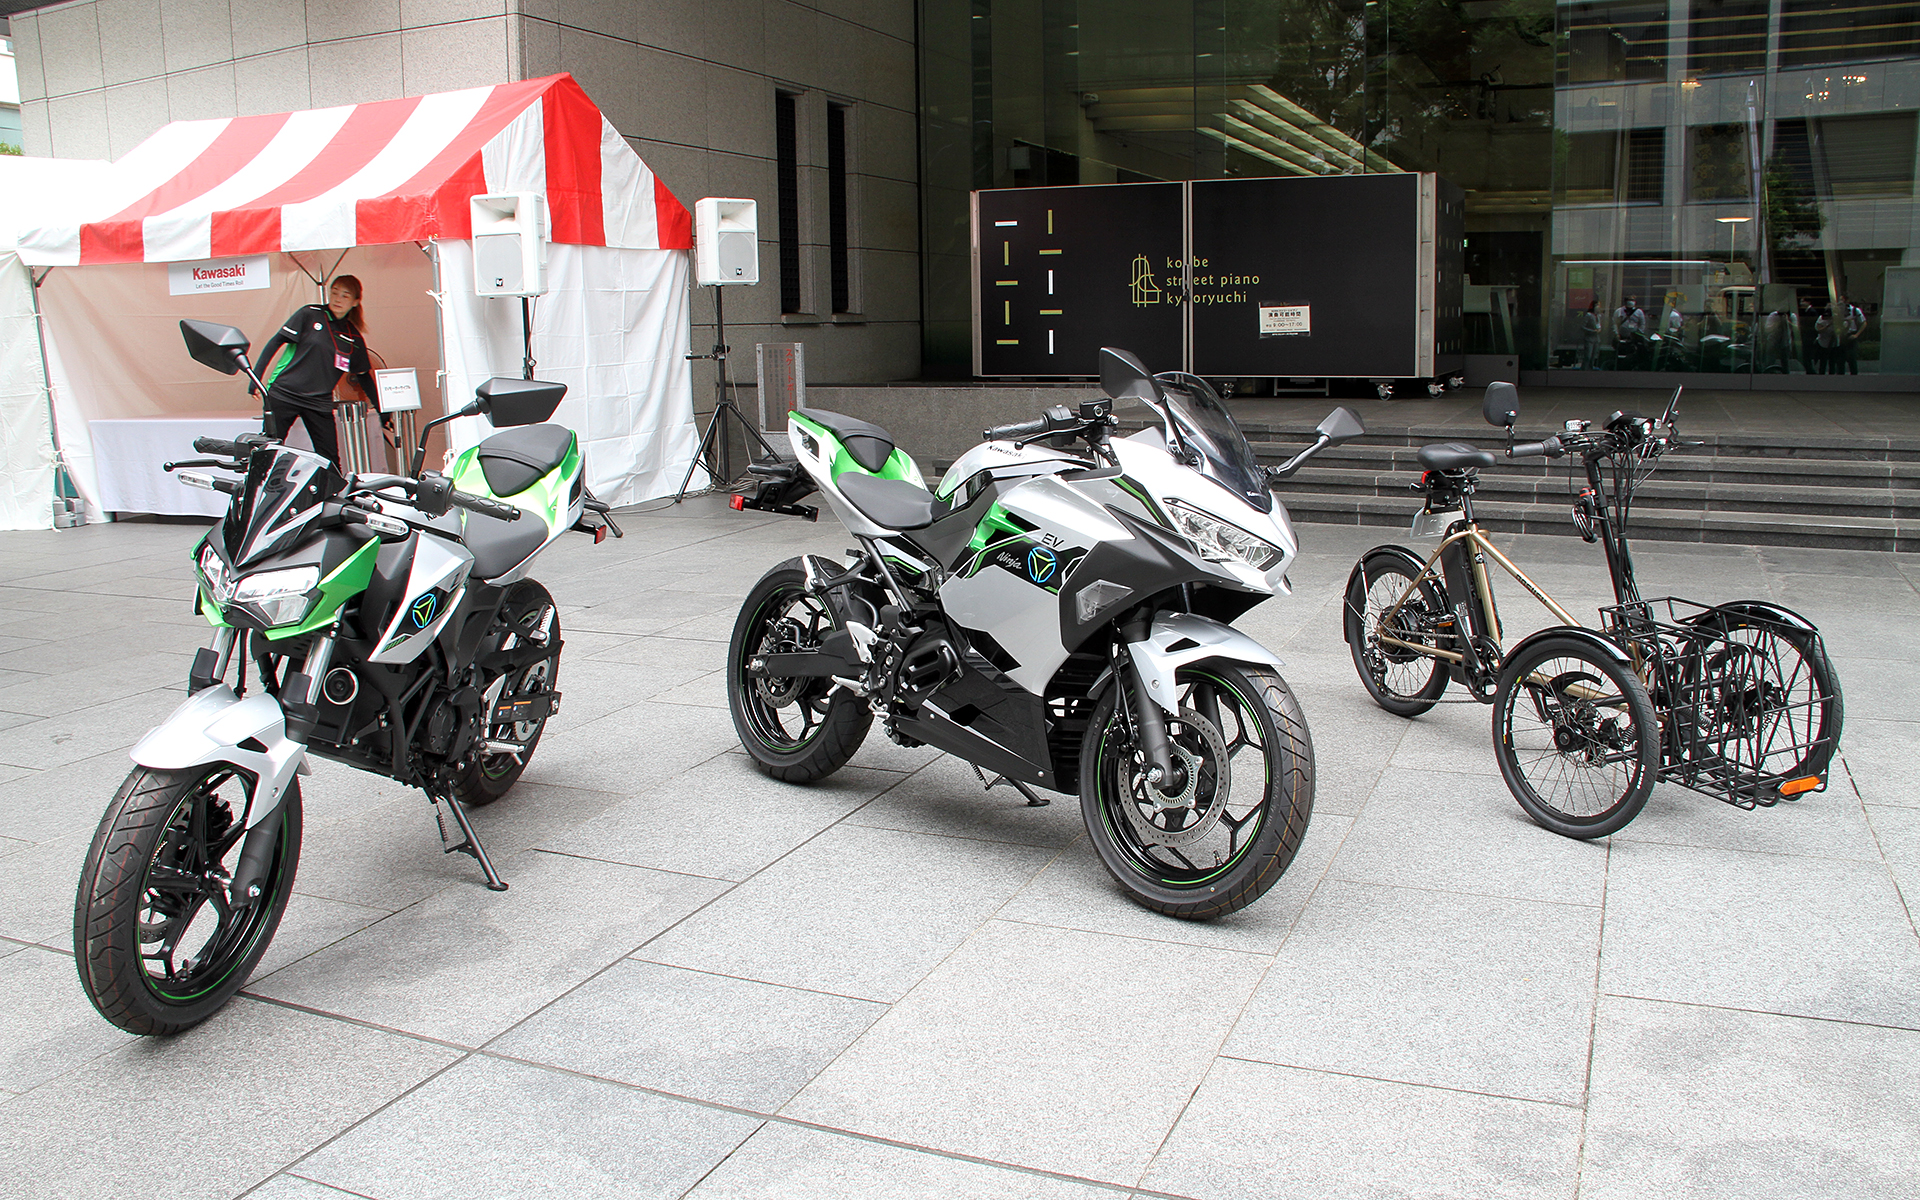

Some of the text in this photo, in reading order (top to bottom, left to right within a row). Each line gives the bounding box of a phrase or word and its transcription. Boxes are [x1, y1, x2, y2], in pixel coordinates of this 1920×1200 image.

[1166, 255, 1209, 269] kobe
[192, 264, 245, 280] Kawasaki
[1166, 273, 1260, 287] street piano
[1166, 291, 1247, 307] kyoryuchi
[986, 444, 1028, 460] Kawasaki
[1041, 532, 1064, 548] EV
[996, 551, 1022, 570] Ninja
